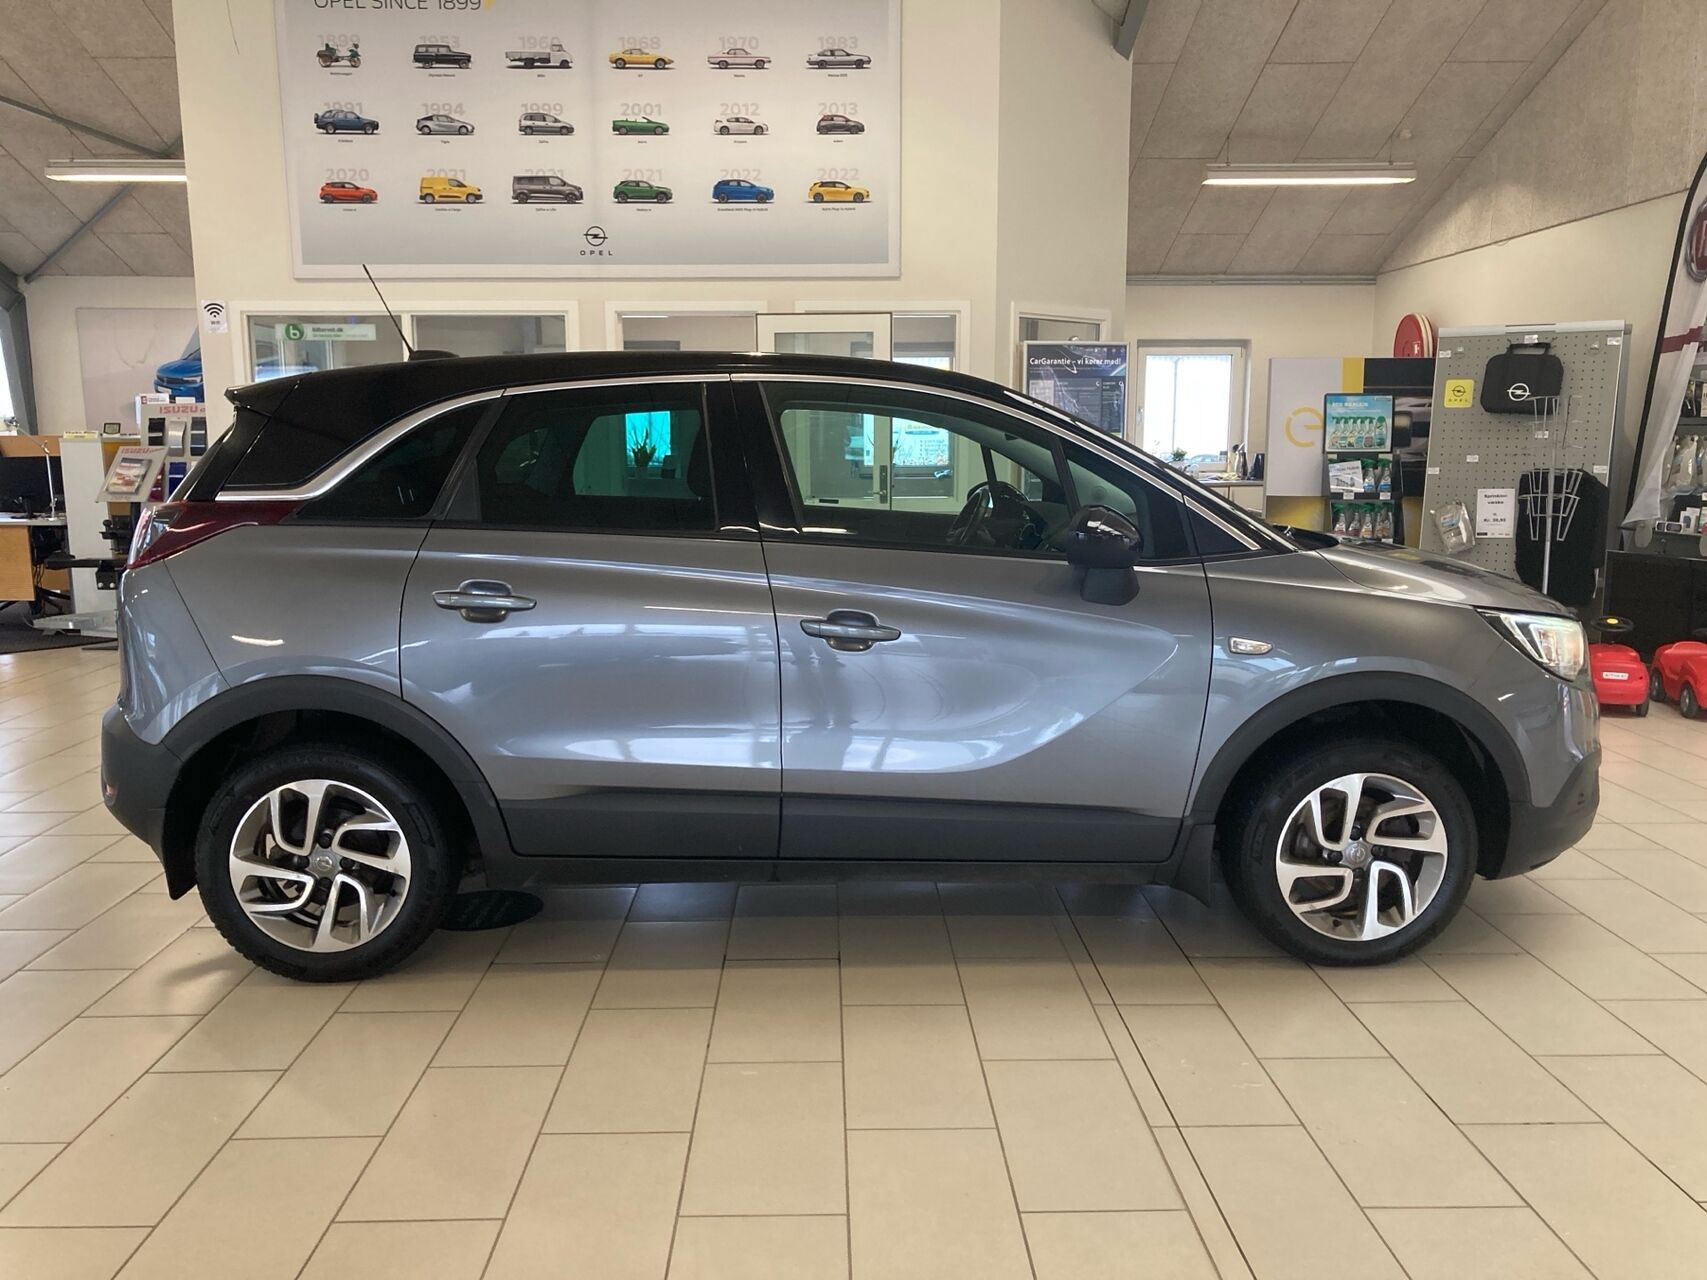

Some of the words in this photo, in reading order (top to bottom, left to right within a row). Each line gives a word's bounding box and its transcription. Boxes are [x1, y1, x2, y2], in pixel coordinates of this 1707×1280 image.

[314, 0, 366, 8] OPEL
[371, 0, 428, 9] SINCE
[438, 0, 481, 10] 1899
[618, 36, 660, 50] 1968
[719, 36, 759, 50] 1970
[817, 36, 858, 49] 1983
[421, 102, 465, 116] 1994
[521, 103, 563, 116] 1999
[620, 103, 662, 116] 2001
[720, 103, 760, 116] 2012
[818, 102, 858, 115] 2013
[326, 168, 369, 181] 2020
[623, 168, 664, 182] 2021
[817, 168, 860, 181] 2022
[1029, 357, 1071, 365] CarGarantie
[159, 405, 199, 414] ISUZU
